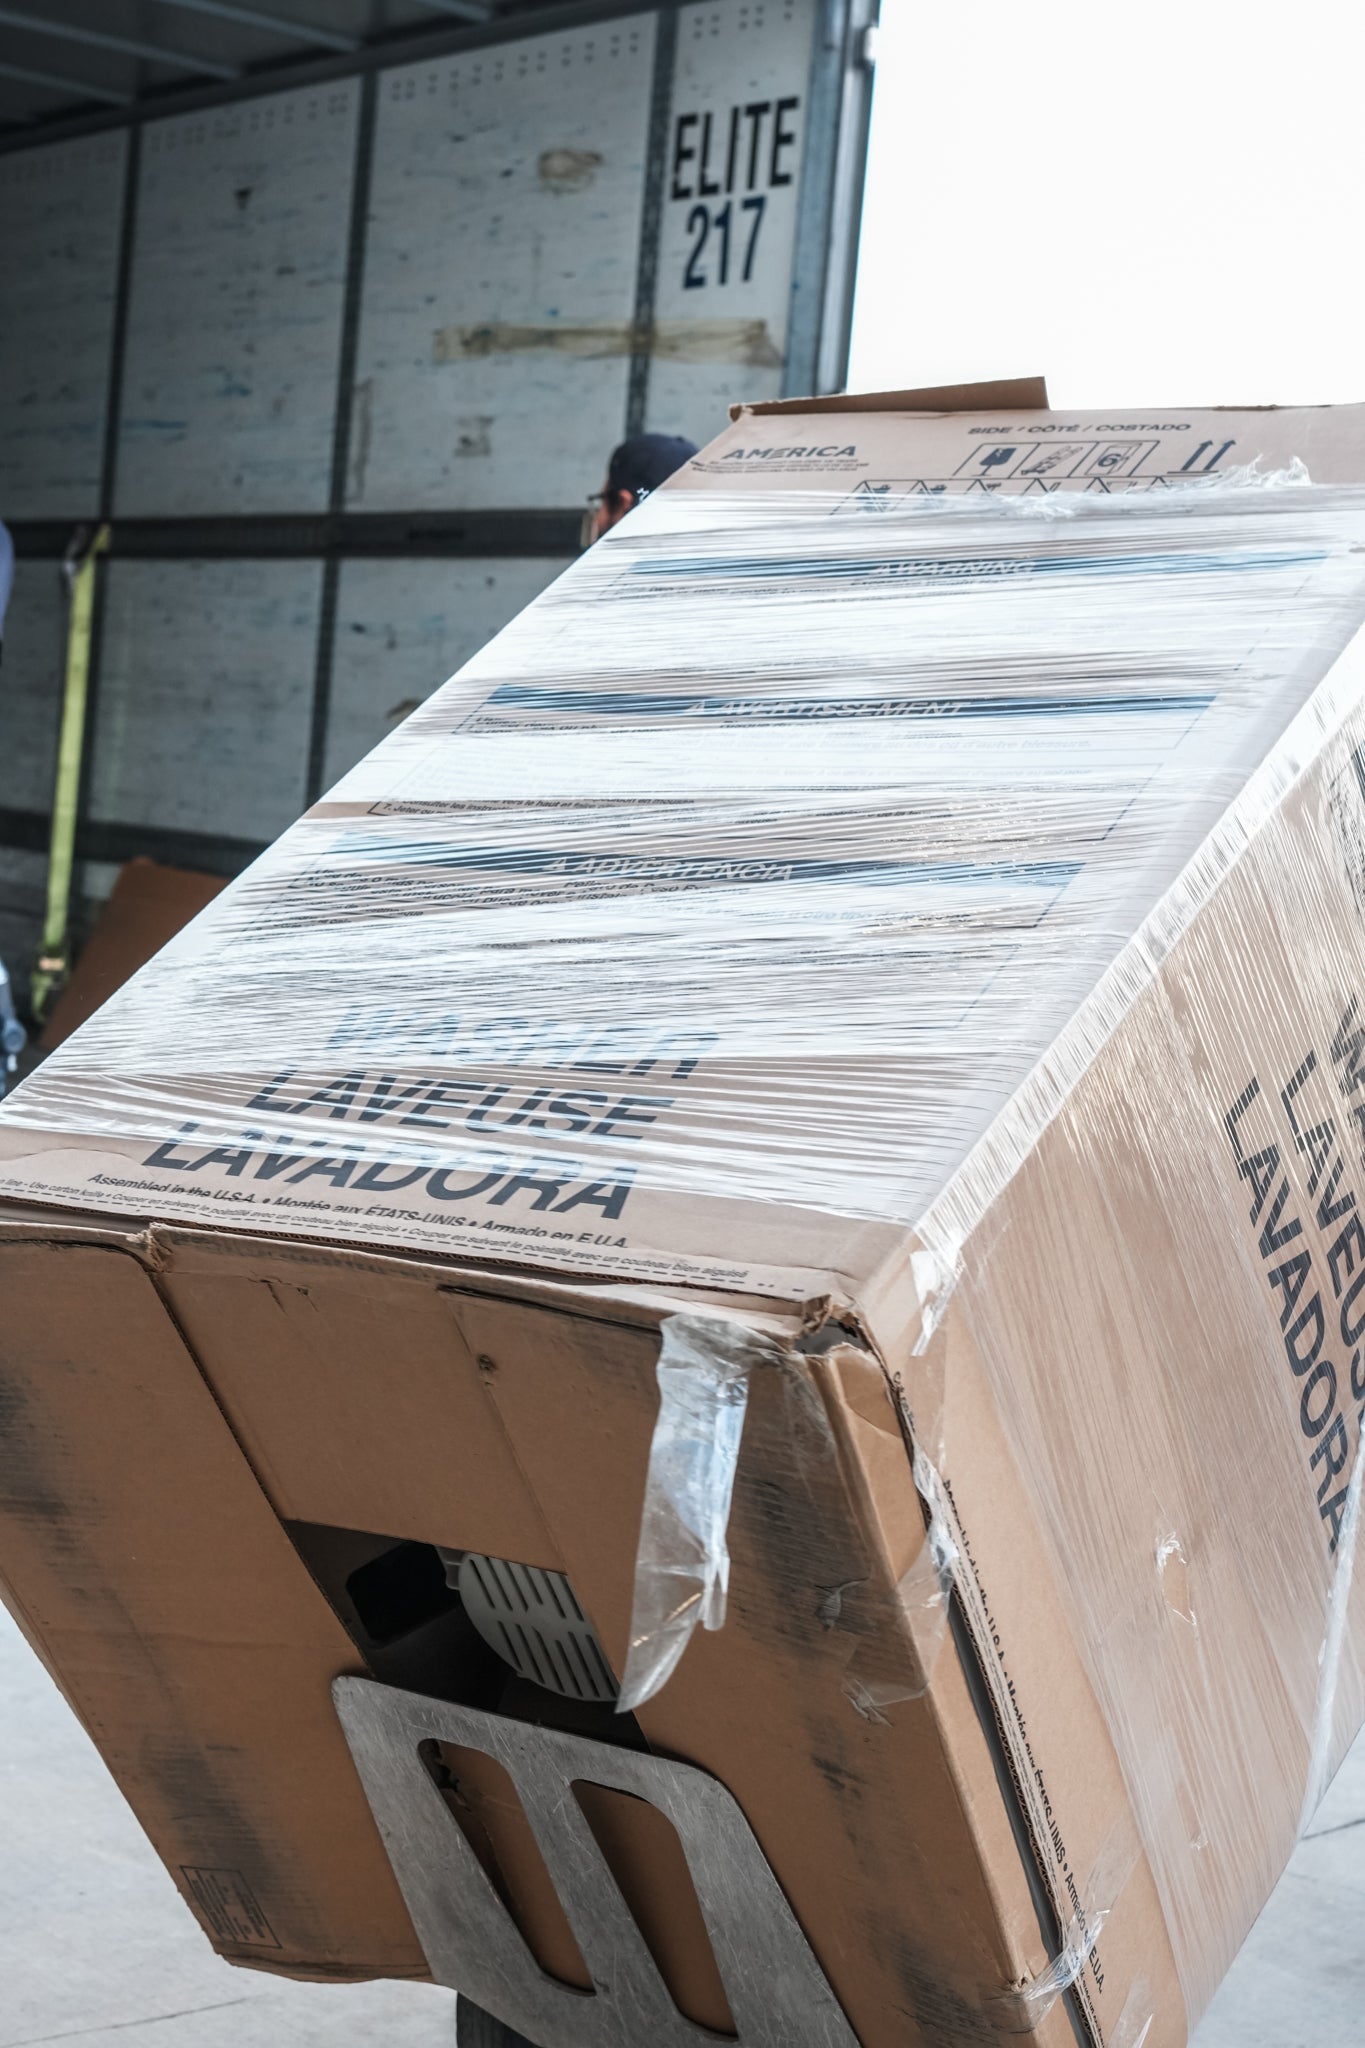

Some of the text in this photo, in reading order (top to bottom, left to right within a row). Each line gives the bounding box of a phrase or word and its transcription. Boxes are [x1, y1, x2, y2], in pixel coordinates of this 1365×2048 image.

[671, 97, 800, 201] ELITE
[683, 196, 767, 289] 217
[721, 445, 857, 460] AMERICA
[968, 426, 1013, 434] SIDE
[1028, 424, 1081, 434] CÔTÉ
[1095, 424, 1192, 432] COSTADO
[896, 561, 1036, 576] WARNING
[721, 700, 973, 717] AVERTISSEMENT
[576, 857, 794, 881] ADVERTENCIA
[327, 1004, 719, 1080] WASHER
[246, 1064, 674, 1140] LAVEUSE
[88, 1174, 169, 1193] Assembled
[171, 1185, 188, 1194] in
[189, 1186, 212, 1198] the
[274, 1197, 330, 1211] Montée
[331, 1204, 362, 1213] aux
[364, 1203, 466, 1227] ÉTATS-UNIS
[480, 1220, 547, 1237] Armado
[551, 1231, 574, 1241] en
[142, 1121, 641, 1220] LAVADORA
[29, 1181, 48, 1190] Use
[409, 1227, 450, 1239] Couper
[513, 1241, 523, 1249] le
[572, 1251, 602, 1261] avec
[602, 1255, 620, 1263] un
[672, 1262, 702, 1273] bien
[1281, 1048, 1365, 1432] LAVEU
[1223, 1075, 1351, 1554] LAVADORA
[1065, 1872, 1089, 1932] Armado
